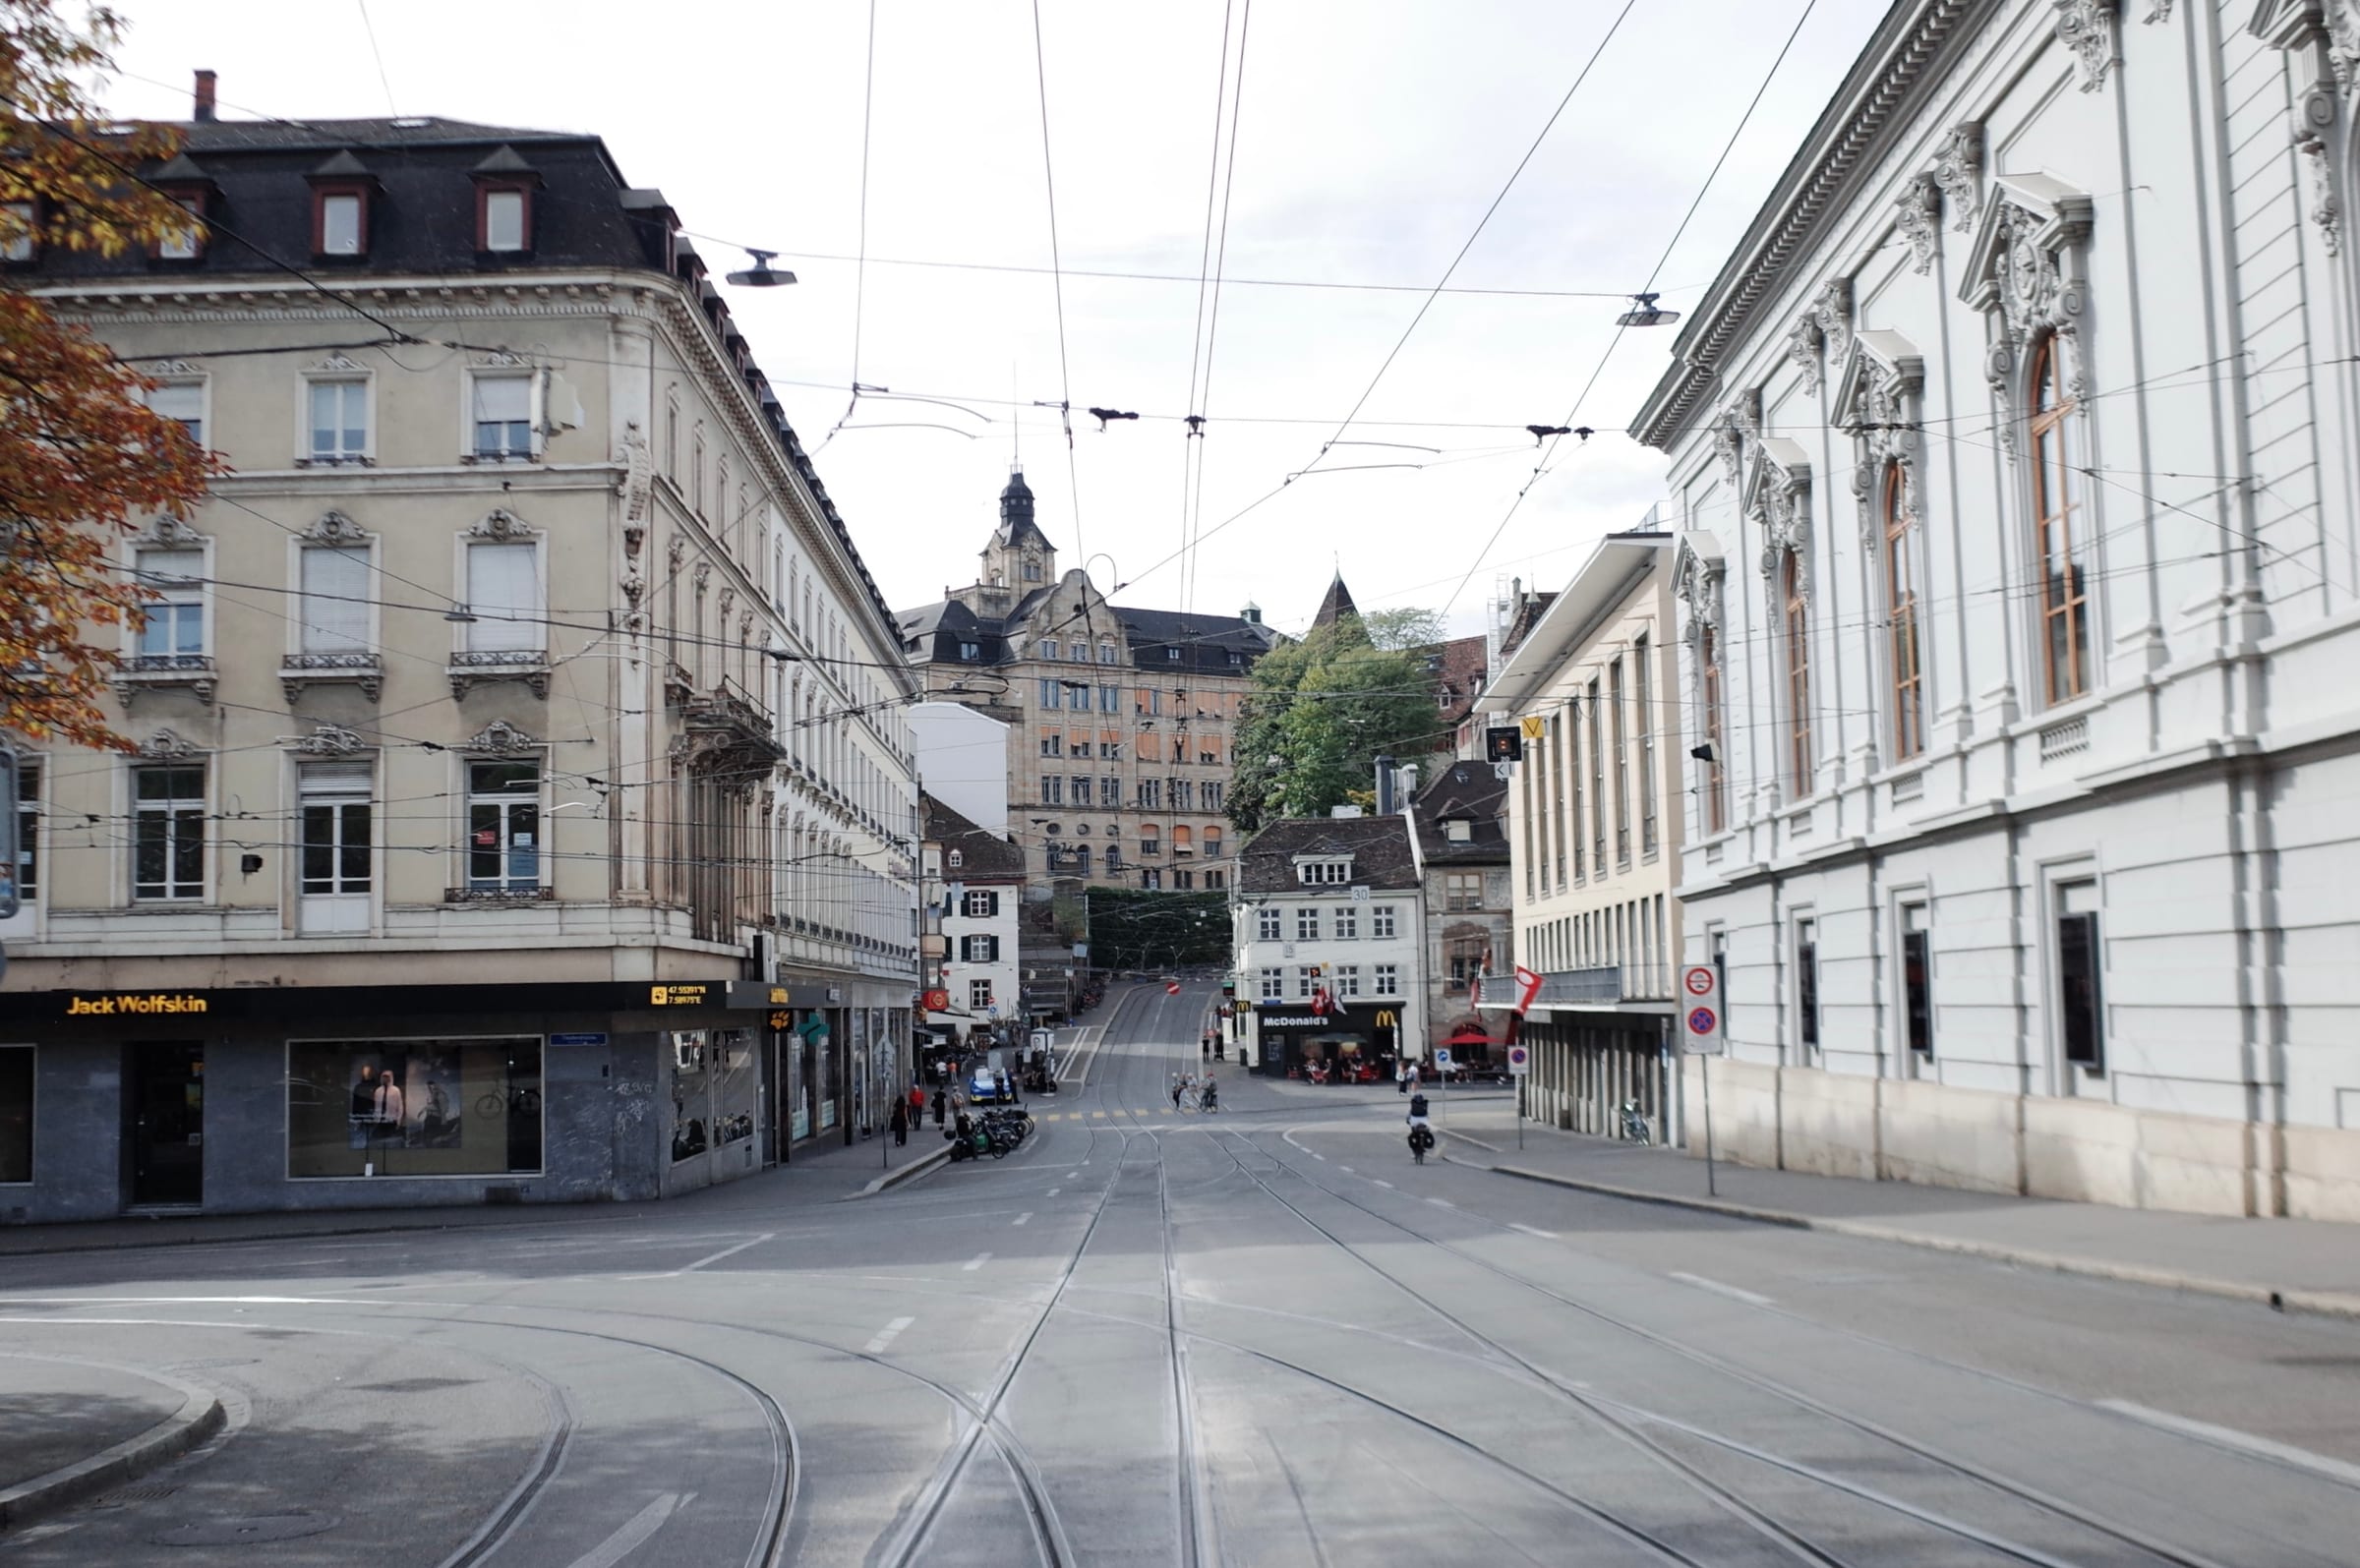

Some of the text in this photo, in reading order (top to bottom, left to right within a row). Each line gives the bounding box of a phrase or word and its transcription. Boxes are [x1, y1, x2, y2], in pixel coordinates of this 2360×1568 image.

[1353, 889, 1368, 900] 30
[67, 995, 206, 1015] Jack Wolfskin
[1264, 1016, 1328, 1026] McDonald's
